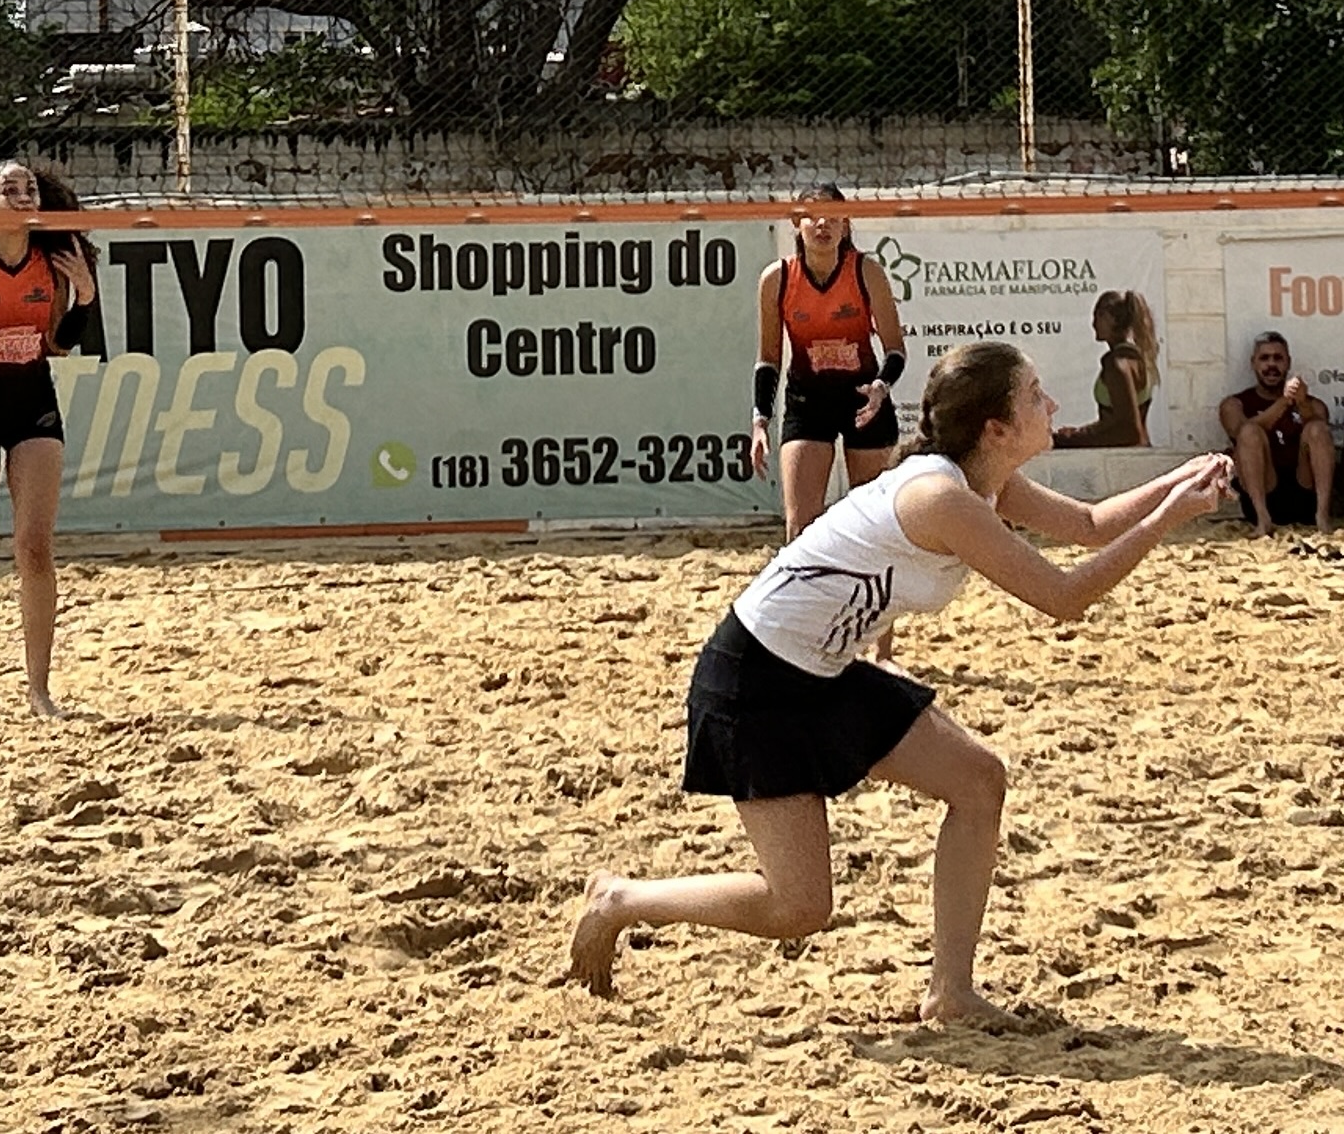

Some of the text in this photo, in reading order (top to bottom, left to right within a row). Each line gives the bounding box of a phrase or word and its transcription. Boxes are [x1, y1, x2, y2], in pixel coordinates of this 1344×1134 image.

[381, 229, 737, 297] Shopping do
[923, 258, 1097, 283] FARMAFLORA
[923, 280, 1099, 297] FARMÁCIA DE MANIPULAÇÃO
[465, 317, 657, 379] Centro
[921, 320, 1006, 339] INSPIRAÇÃO
[1021, 322, 1034, 335] O
[1036, 320, 1063, 335] SEU
[431, 433, 755, 489] (18) 3652-3233
